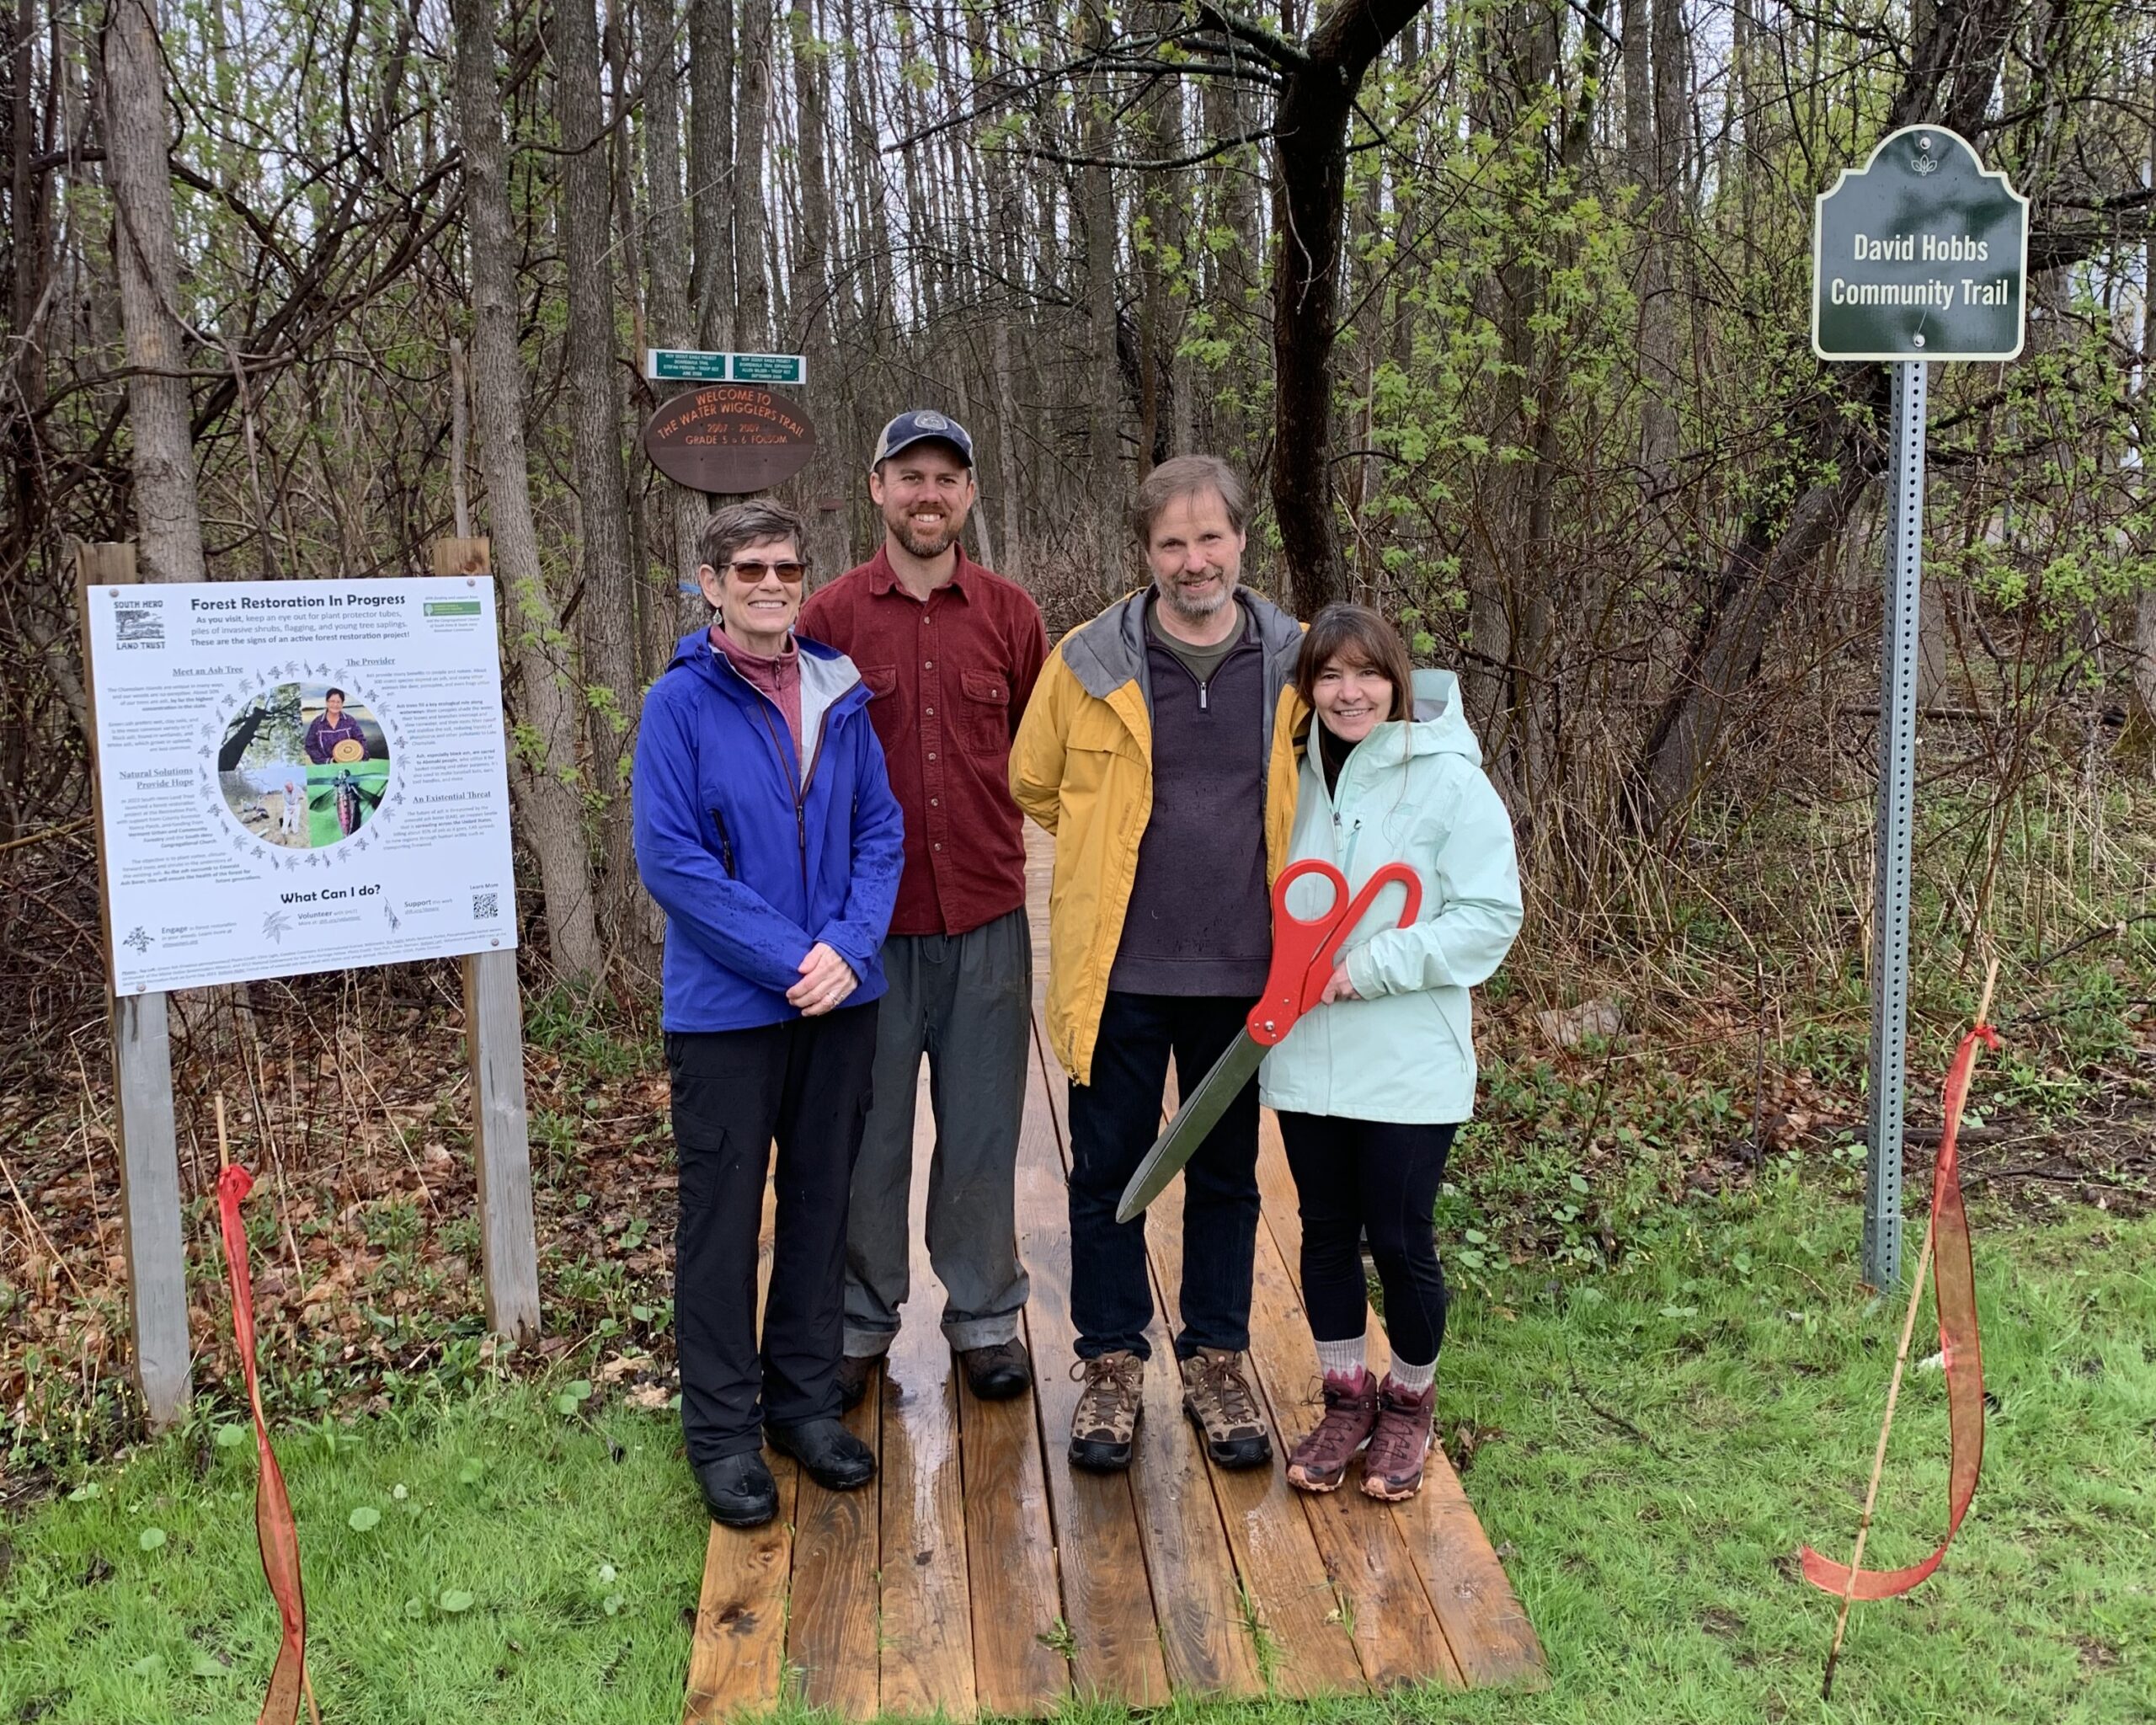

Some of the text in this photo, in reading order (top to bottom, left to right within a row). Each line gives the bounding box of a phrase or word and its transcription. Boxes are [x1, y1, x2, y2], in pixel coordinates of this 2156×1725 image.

[1854, 233, 1988, 262] David Hobbs
[1831, 278, 2008, 310] Community Trail
[696, 389, 771, 406] WELCOME TO
[657, 403, 805, 440] THE WATER WIGGLERS TRAIL
[686, 435, 718, 445] GRADE
[114, 600, 163, 609] SOUTH HERO
[190, 595, 405, 611] Forest Restoration In Progress
[225, 614, 244, 623] visit,
[246, 614, 264, 622] keep
[321, 611, 340, 621] plant
[342, 611, 377, 620] protector
[379, 610, 402, 619] tubes,
[191, 627, 210, 636] piles
[254, 624, 282, 633] shrubs,
[284, 623, 317, 633] flagging,
[376, 620, 408, 629] saplings.
[247, 636, 266, 644] signs
[339, 632, 381, 640] restoration
[382, 631, 409, 640] project!
[116, 642, 138, 650] LAND
[362, 657, 395, 665] Provider
[120, 767, 193, 778] Natural Solutions
[136, 779, 194, 789] Provide Hope
[426, 793, 465, 802] Existential
[467, 791, 491, 799] Threat
[280, 884, 381, 904] What Can I do?
[404, 900, 431, 908] Support
